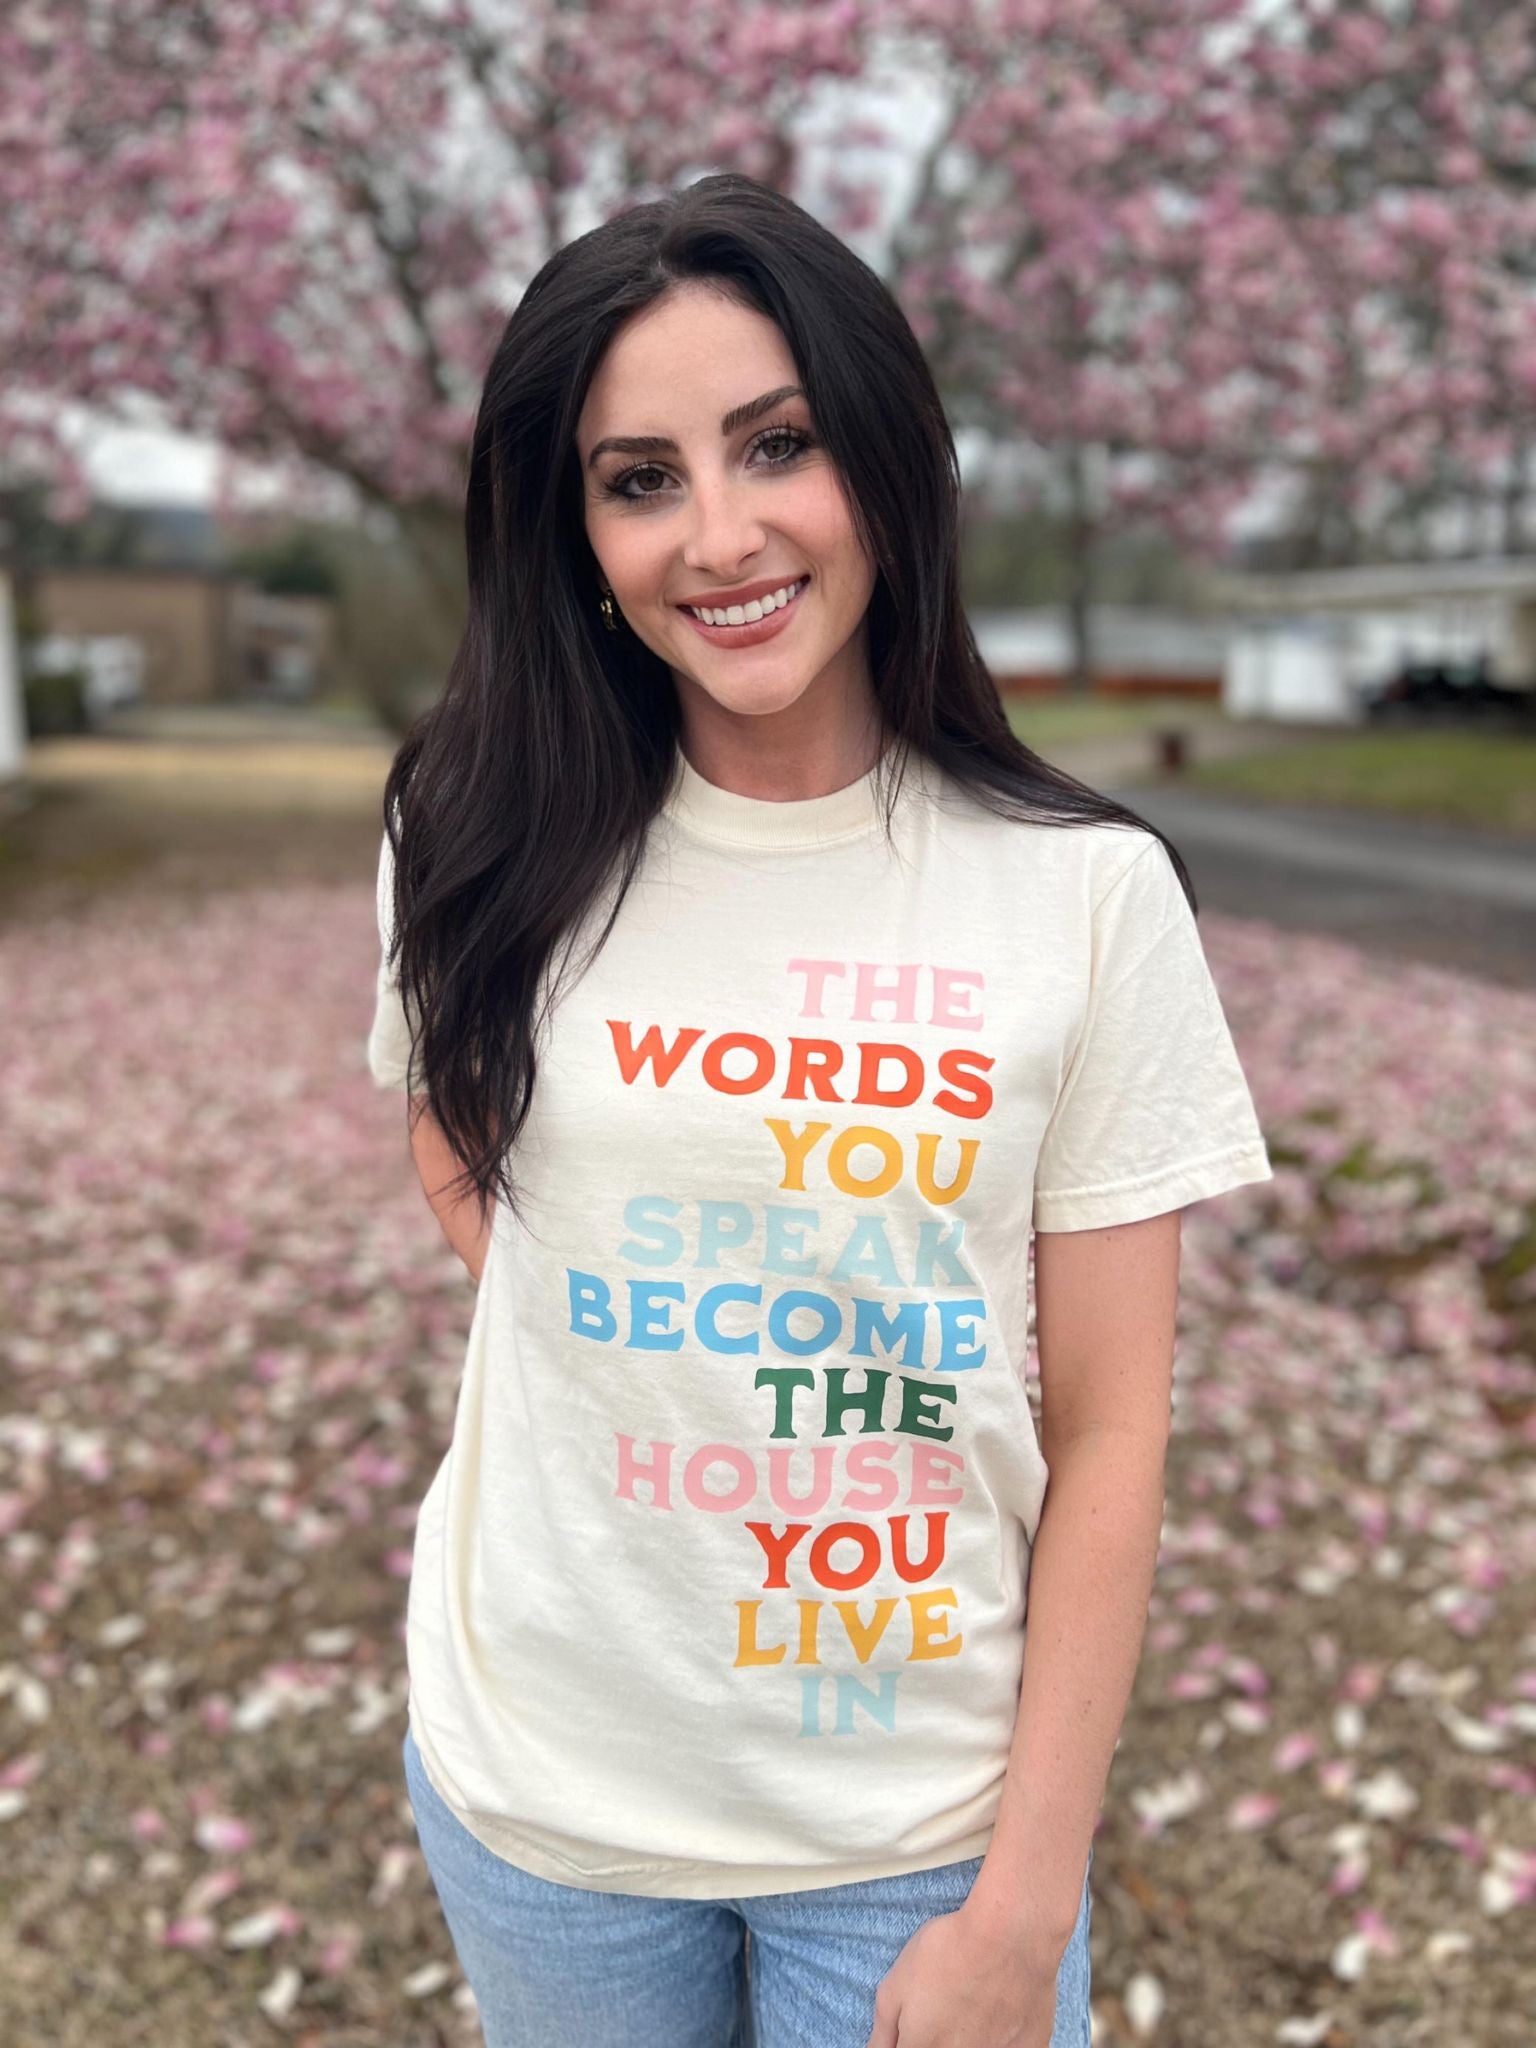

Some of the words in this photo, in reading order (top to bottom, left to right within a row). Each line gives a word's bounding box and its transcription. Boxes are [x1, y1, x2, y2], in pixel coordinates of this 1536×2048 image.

[787, 959, 986, 1032] THE
[606, 1020, 996, 1120] WORDS
[764, 1118, 981, 1206] YOU
[616, 1196, 977, 1288] SPEAK
[566, 1268, 987, 1371] BECOME
[754, 1368, 959, 1442] THE
[614, 1432, 965, 1517] HOUSE
[744, 1511, 950, 1591] YOU
[733, 1587, 963, 1668] LIVE
[799, 1672, 903, 1738] IN
